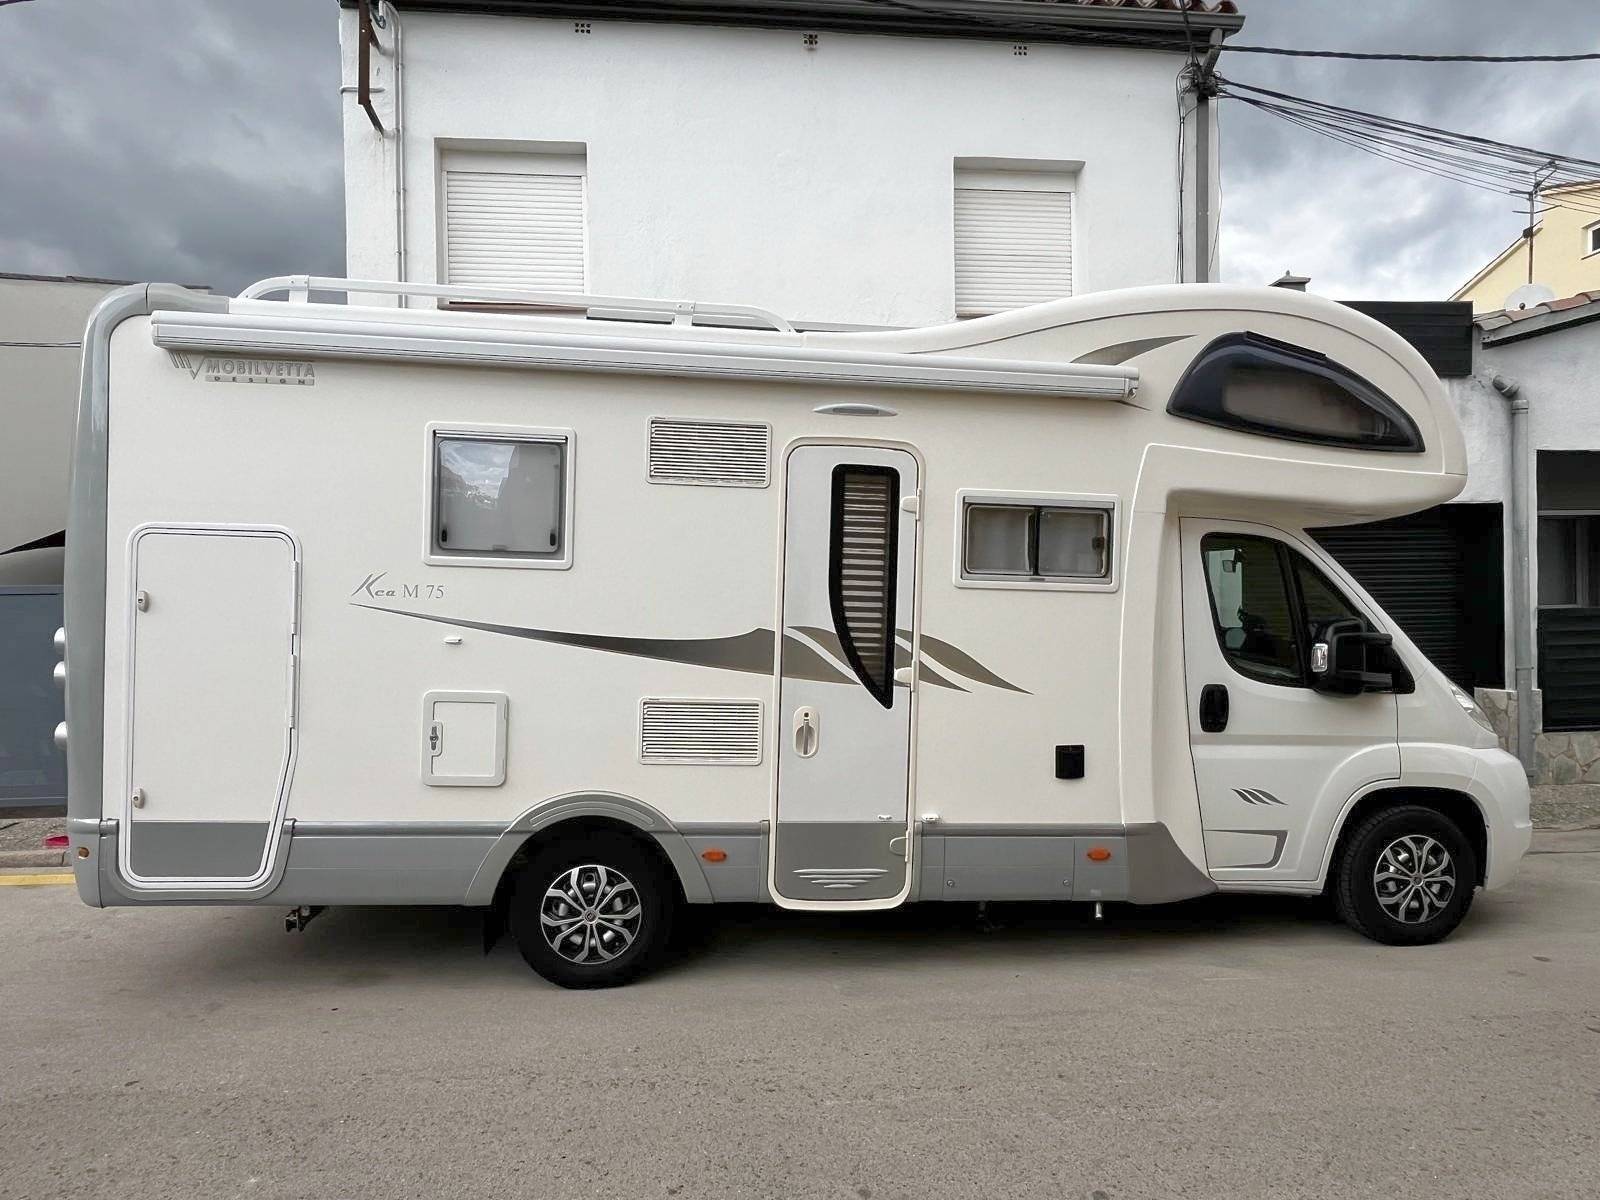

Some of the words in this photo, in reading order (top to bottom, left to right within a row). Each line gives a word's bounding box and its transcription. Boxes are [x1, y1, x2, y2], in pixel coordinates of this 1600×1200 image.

[206, 359, 315, 377] MOBILVETTA
[403, 584, 419, 598] M
[426, 584, 444, 599] 75
